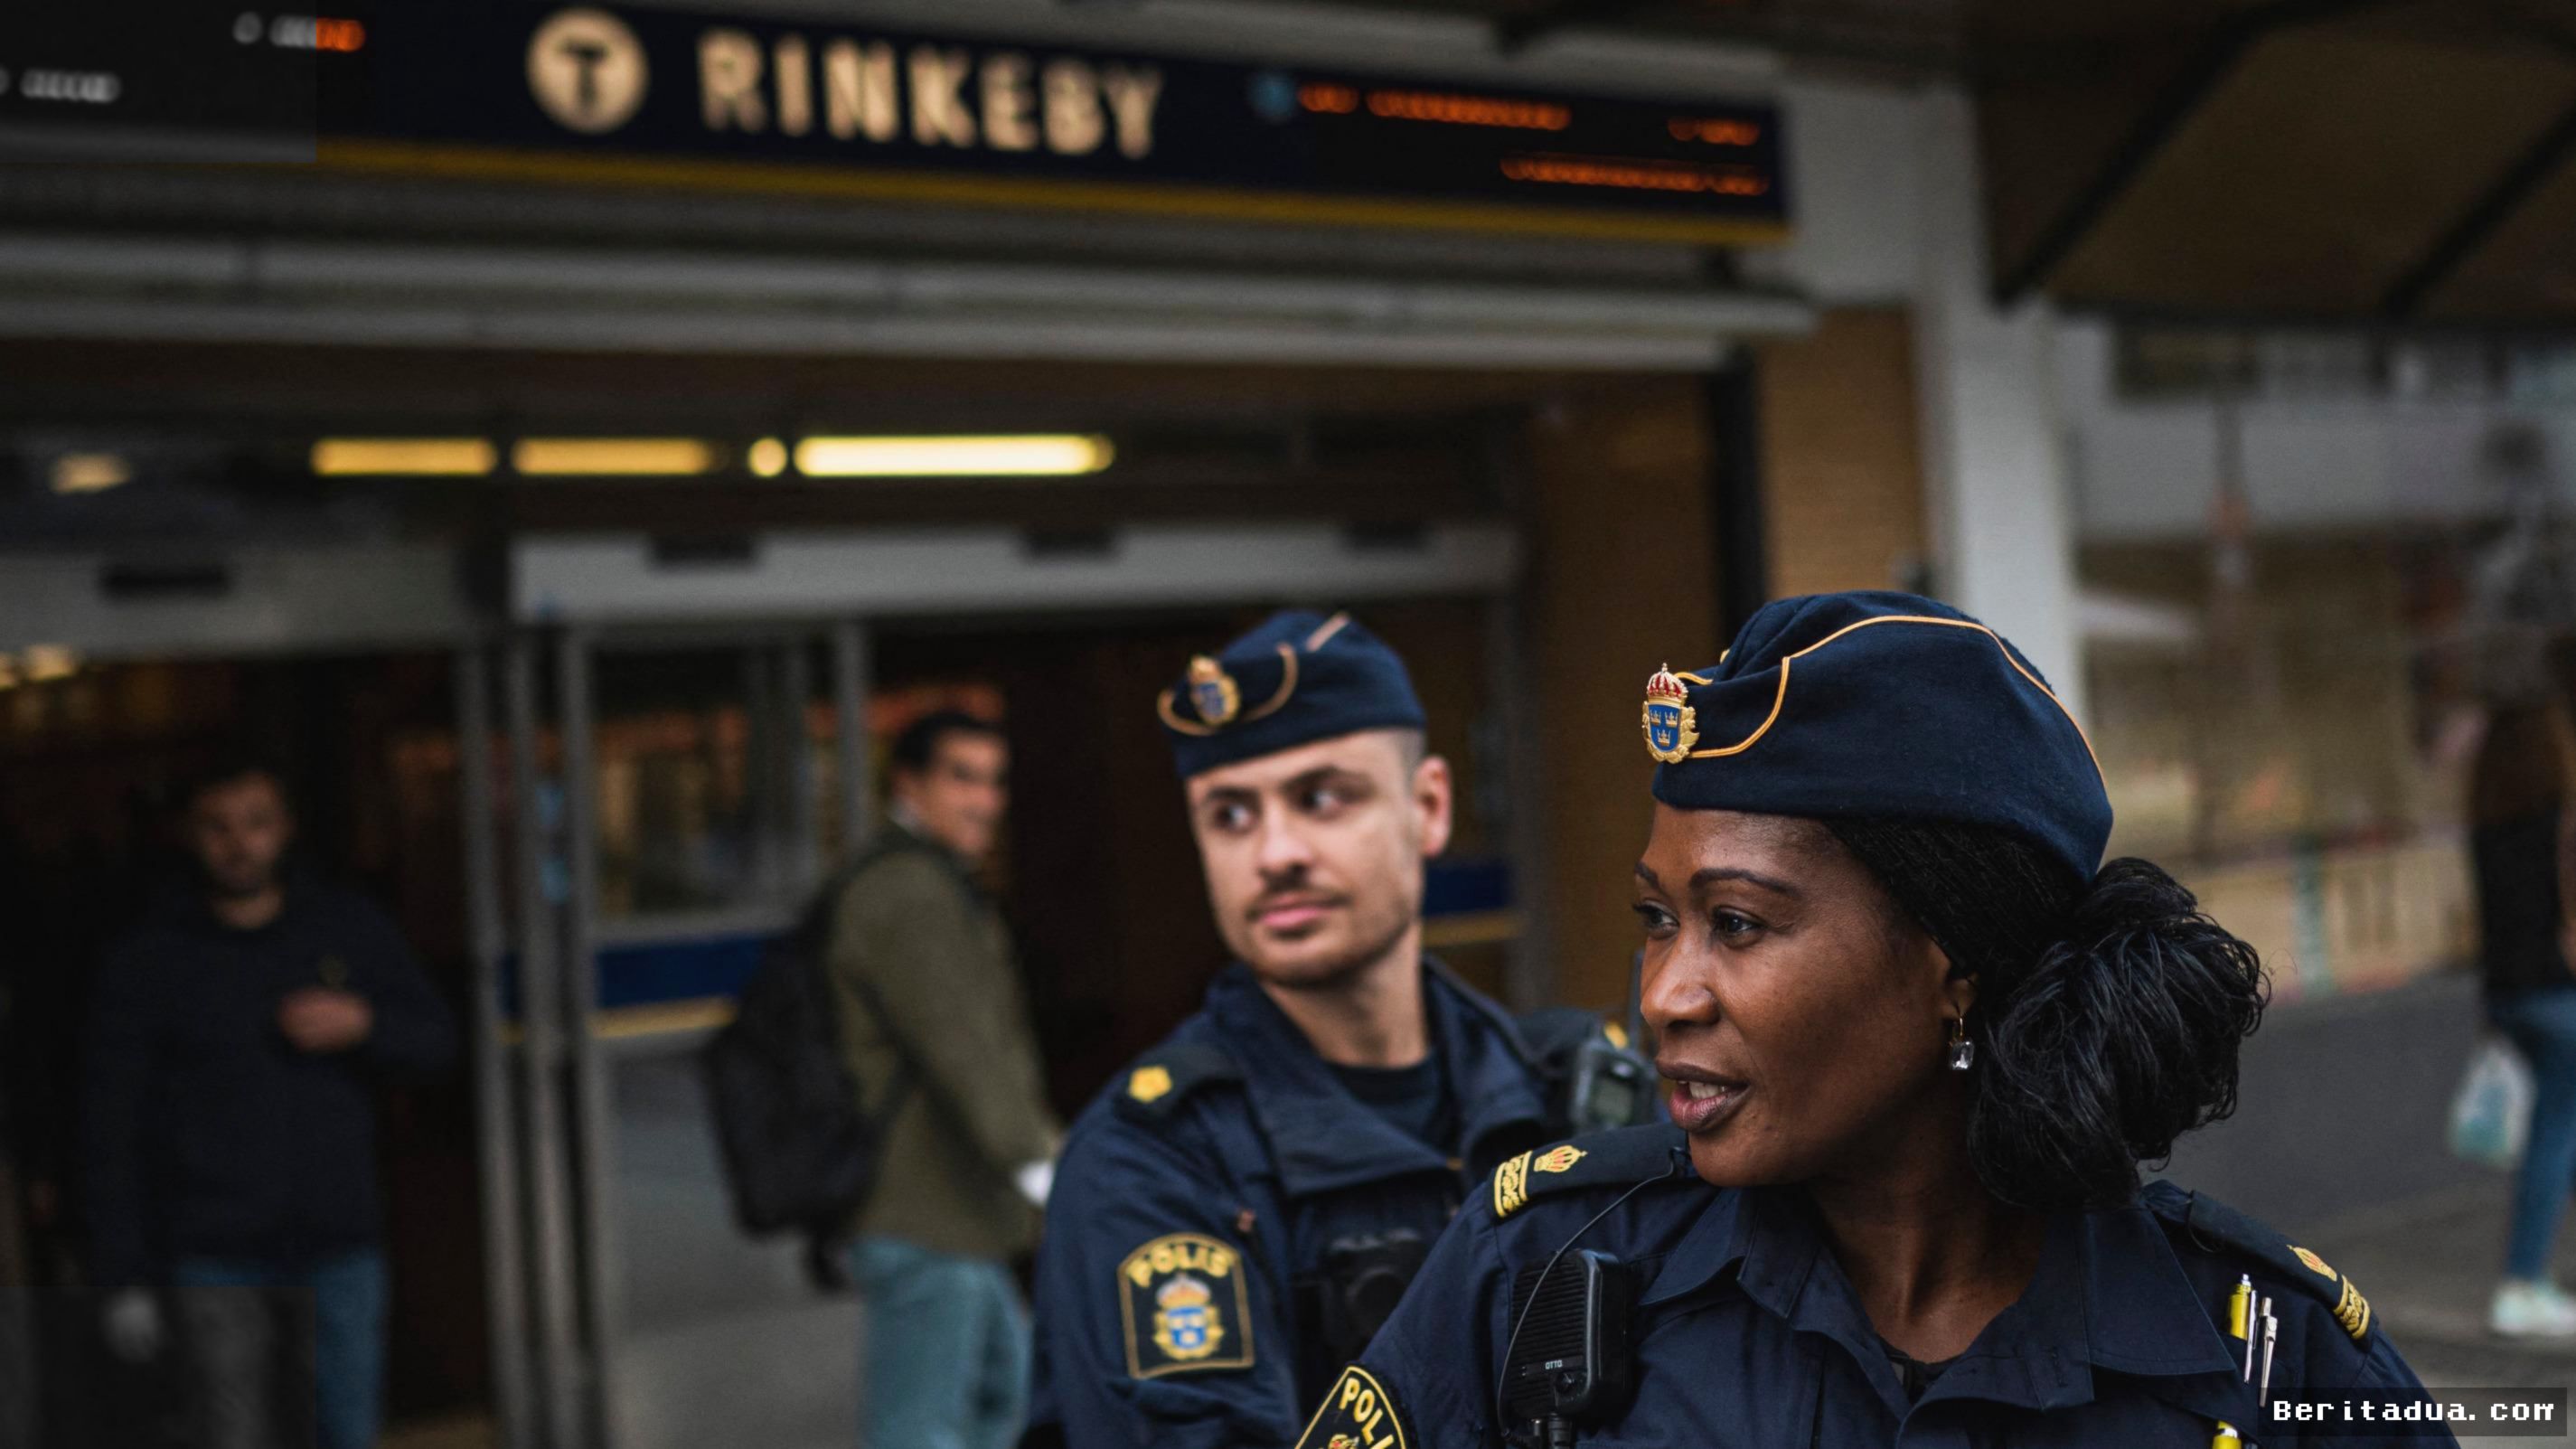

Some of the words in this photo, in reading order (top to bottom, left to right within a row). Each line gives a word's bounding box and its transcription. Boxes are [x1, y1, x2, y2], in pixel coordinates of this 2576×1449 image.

[698, 32, 1162, 159] RINKEBY
[1126, 1242, 1230, 1287] POLIS
[1545, 1360, 1563, 1369] OTTO
